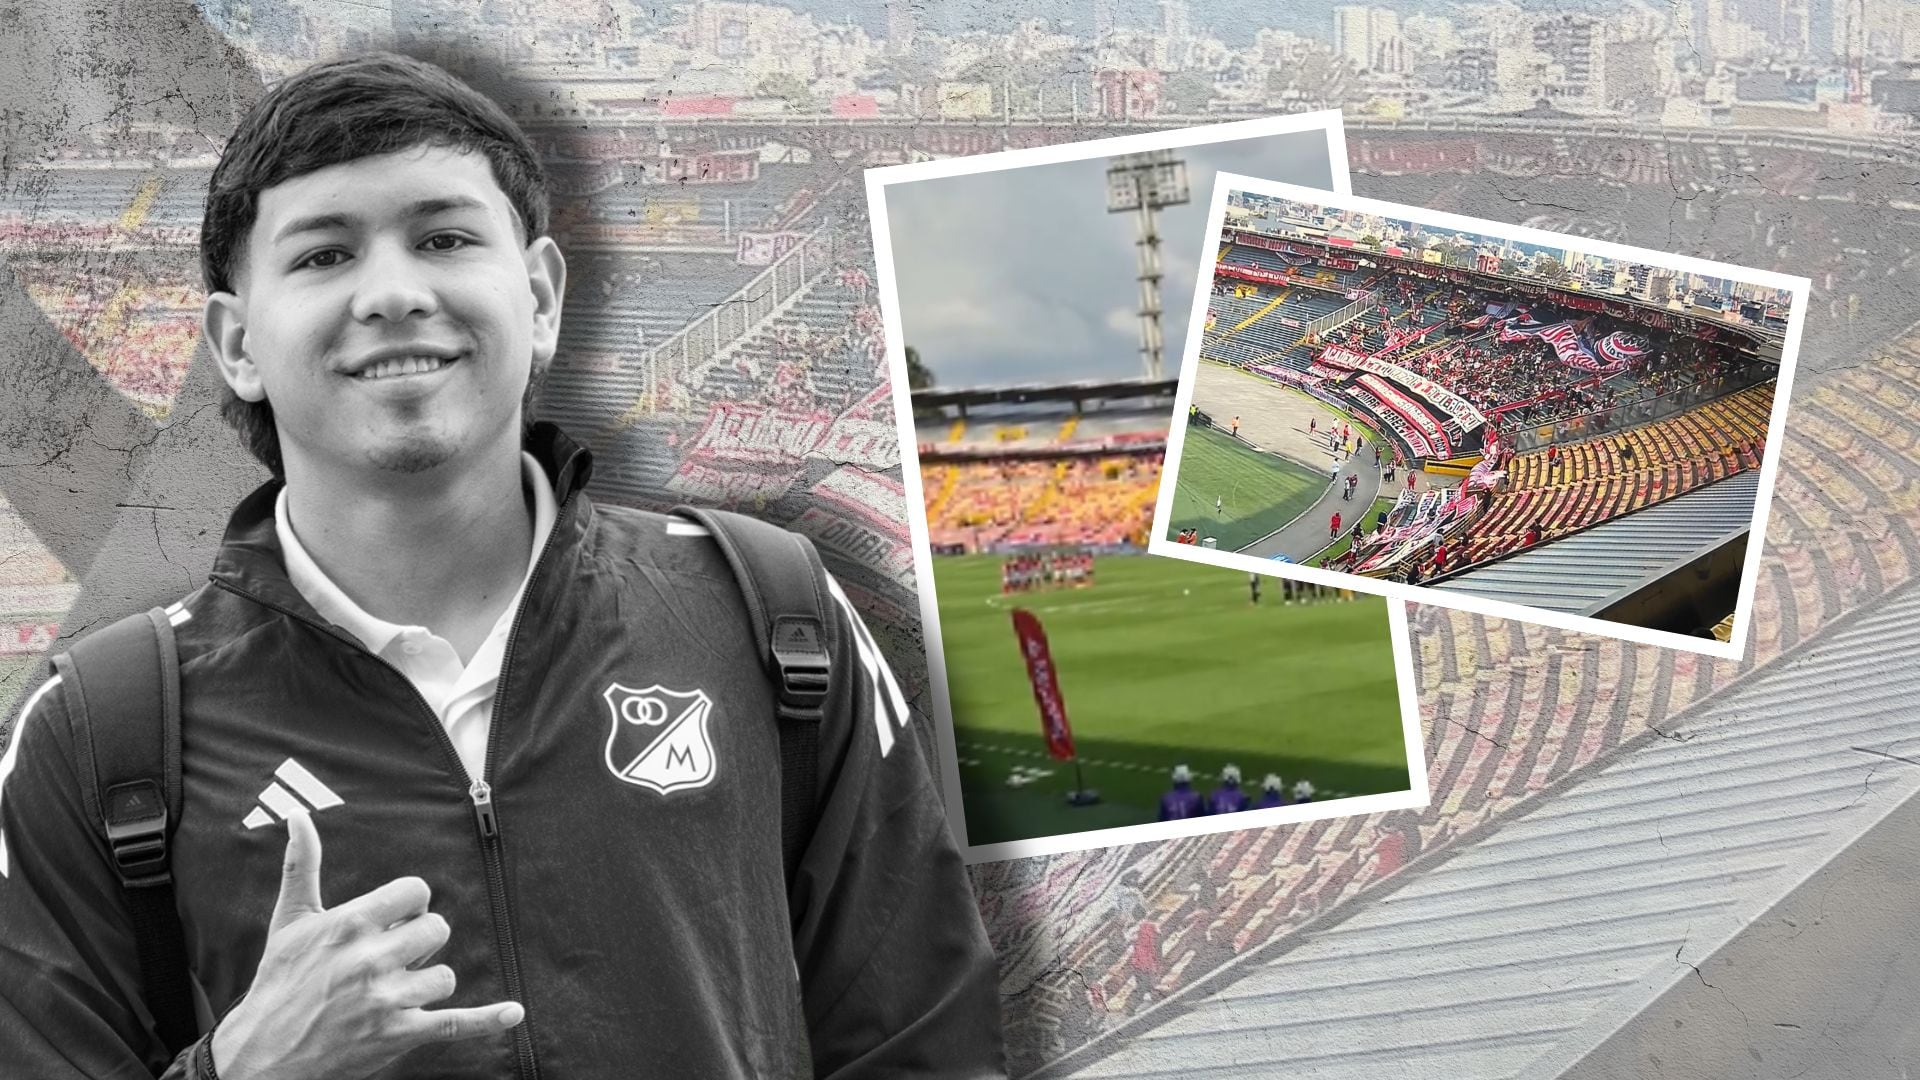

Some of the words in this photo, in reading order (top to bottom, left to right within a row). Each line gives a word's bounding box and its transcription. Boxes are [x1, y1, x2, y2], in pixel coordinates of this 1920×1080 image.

[1355, 390, 1381, 409] OMAR
[1380, 409, 1407, 431] PEREZ
[665, 742, 697, 773] M
